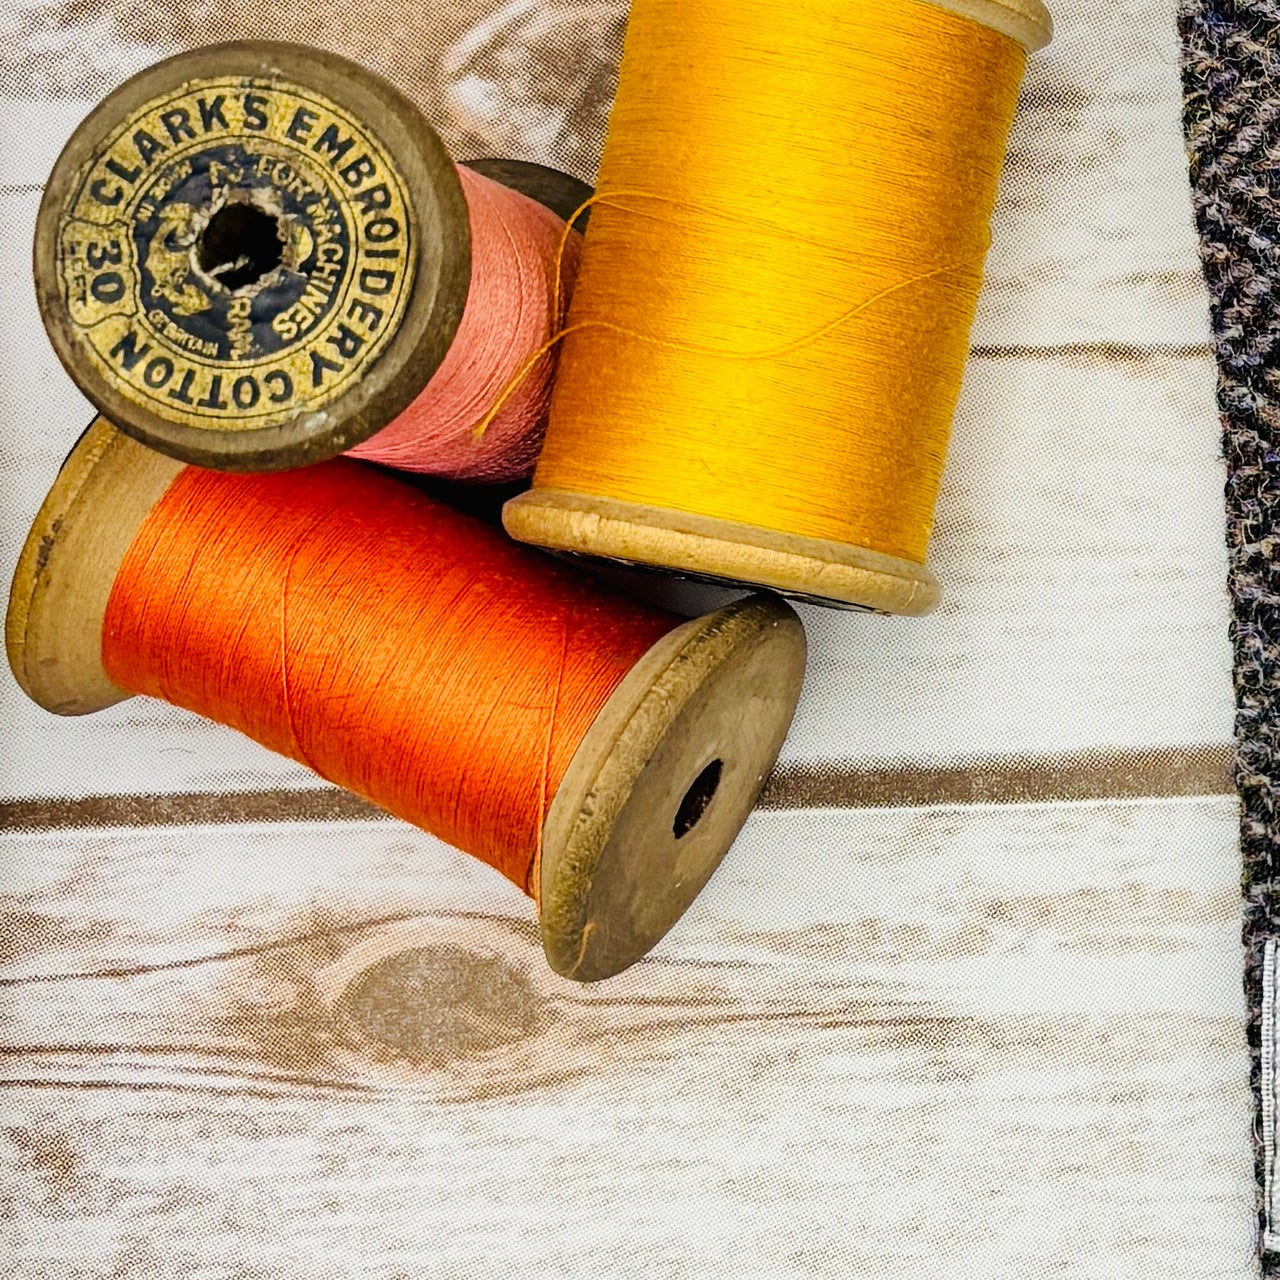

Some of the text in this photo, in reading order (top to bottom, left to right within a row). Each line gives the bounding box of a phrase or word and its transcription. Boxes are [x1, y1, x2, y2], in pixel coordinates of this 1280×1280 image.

[85, 240, 125, 304] 30
[90, 94, 401, 410] CLARK'S EMBROIDERY COTTON
[272, 198, 345, 340] MACHINES
